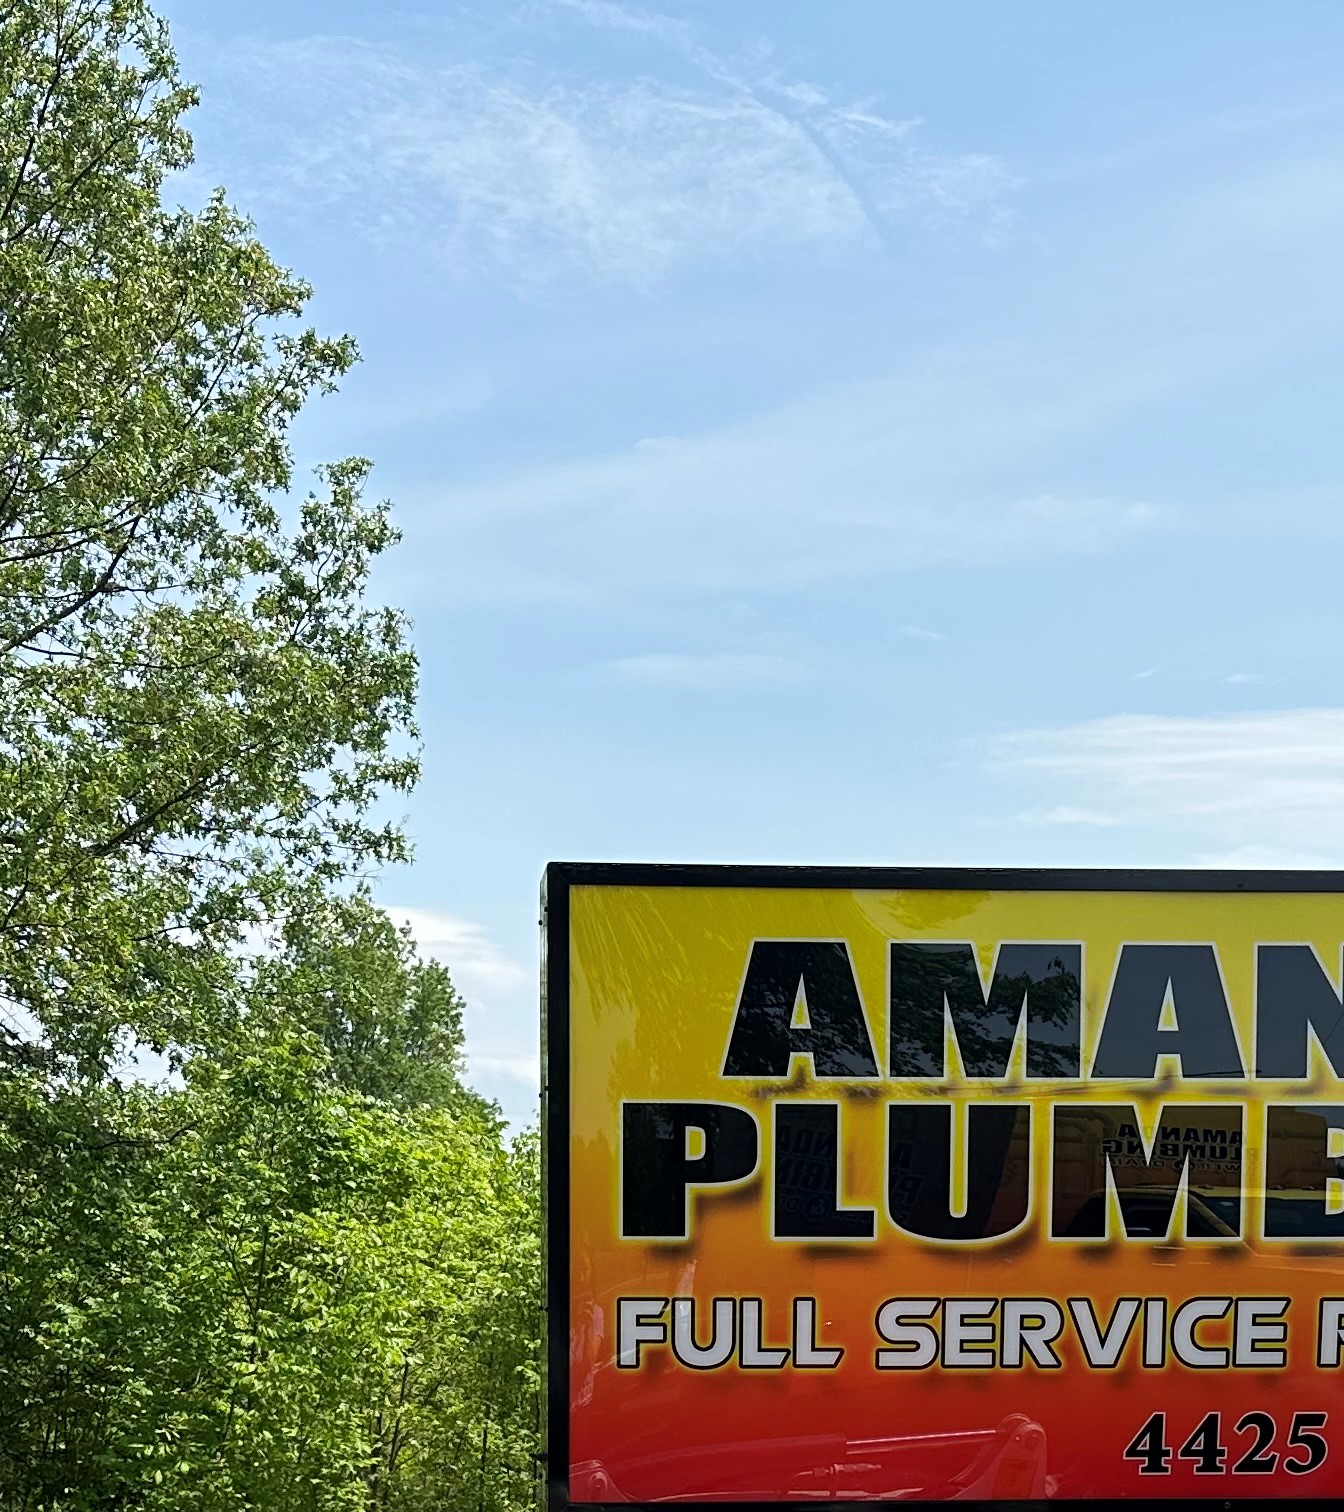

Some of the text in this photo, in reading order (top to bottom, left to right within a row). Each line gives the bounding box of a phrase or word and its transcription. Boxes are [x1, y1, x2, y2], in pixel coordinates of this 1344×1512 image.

[617, 1297, 844, 1369] FULL
[875, 1297, 1291, 1370] SERVICE
[1123, 1411, 1328, 1475] 4425
